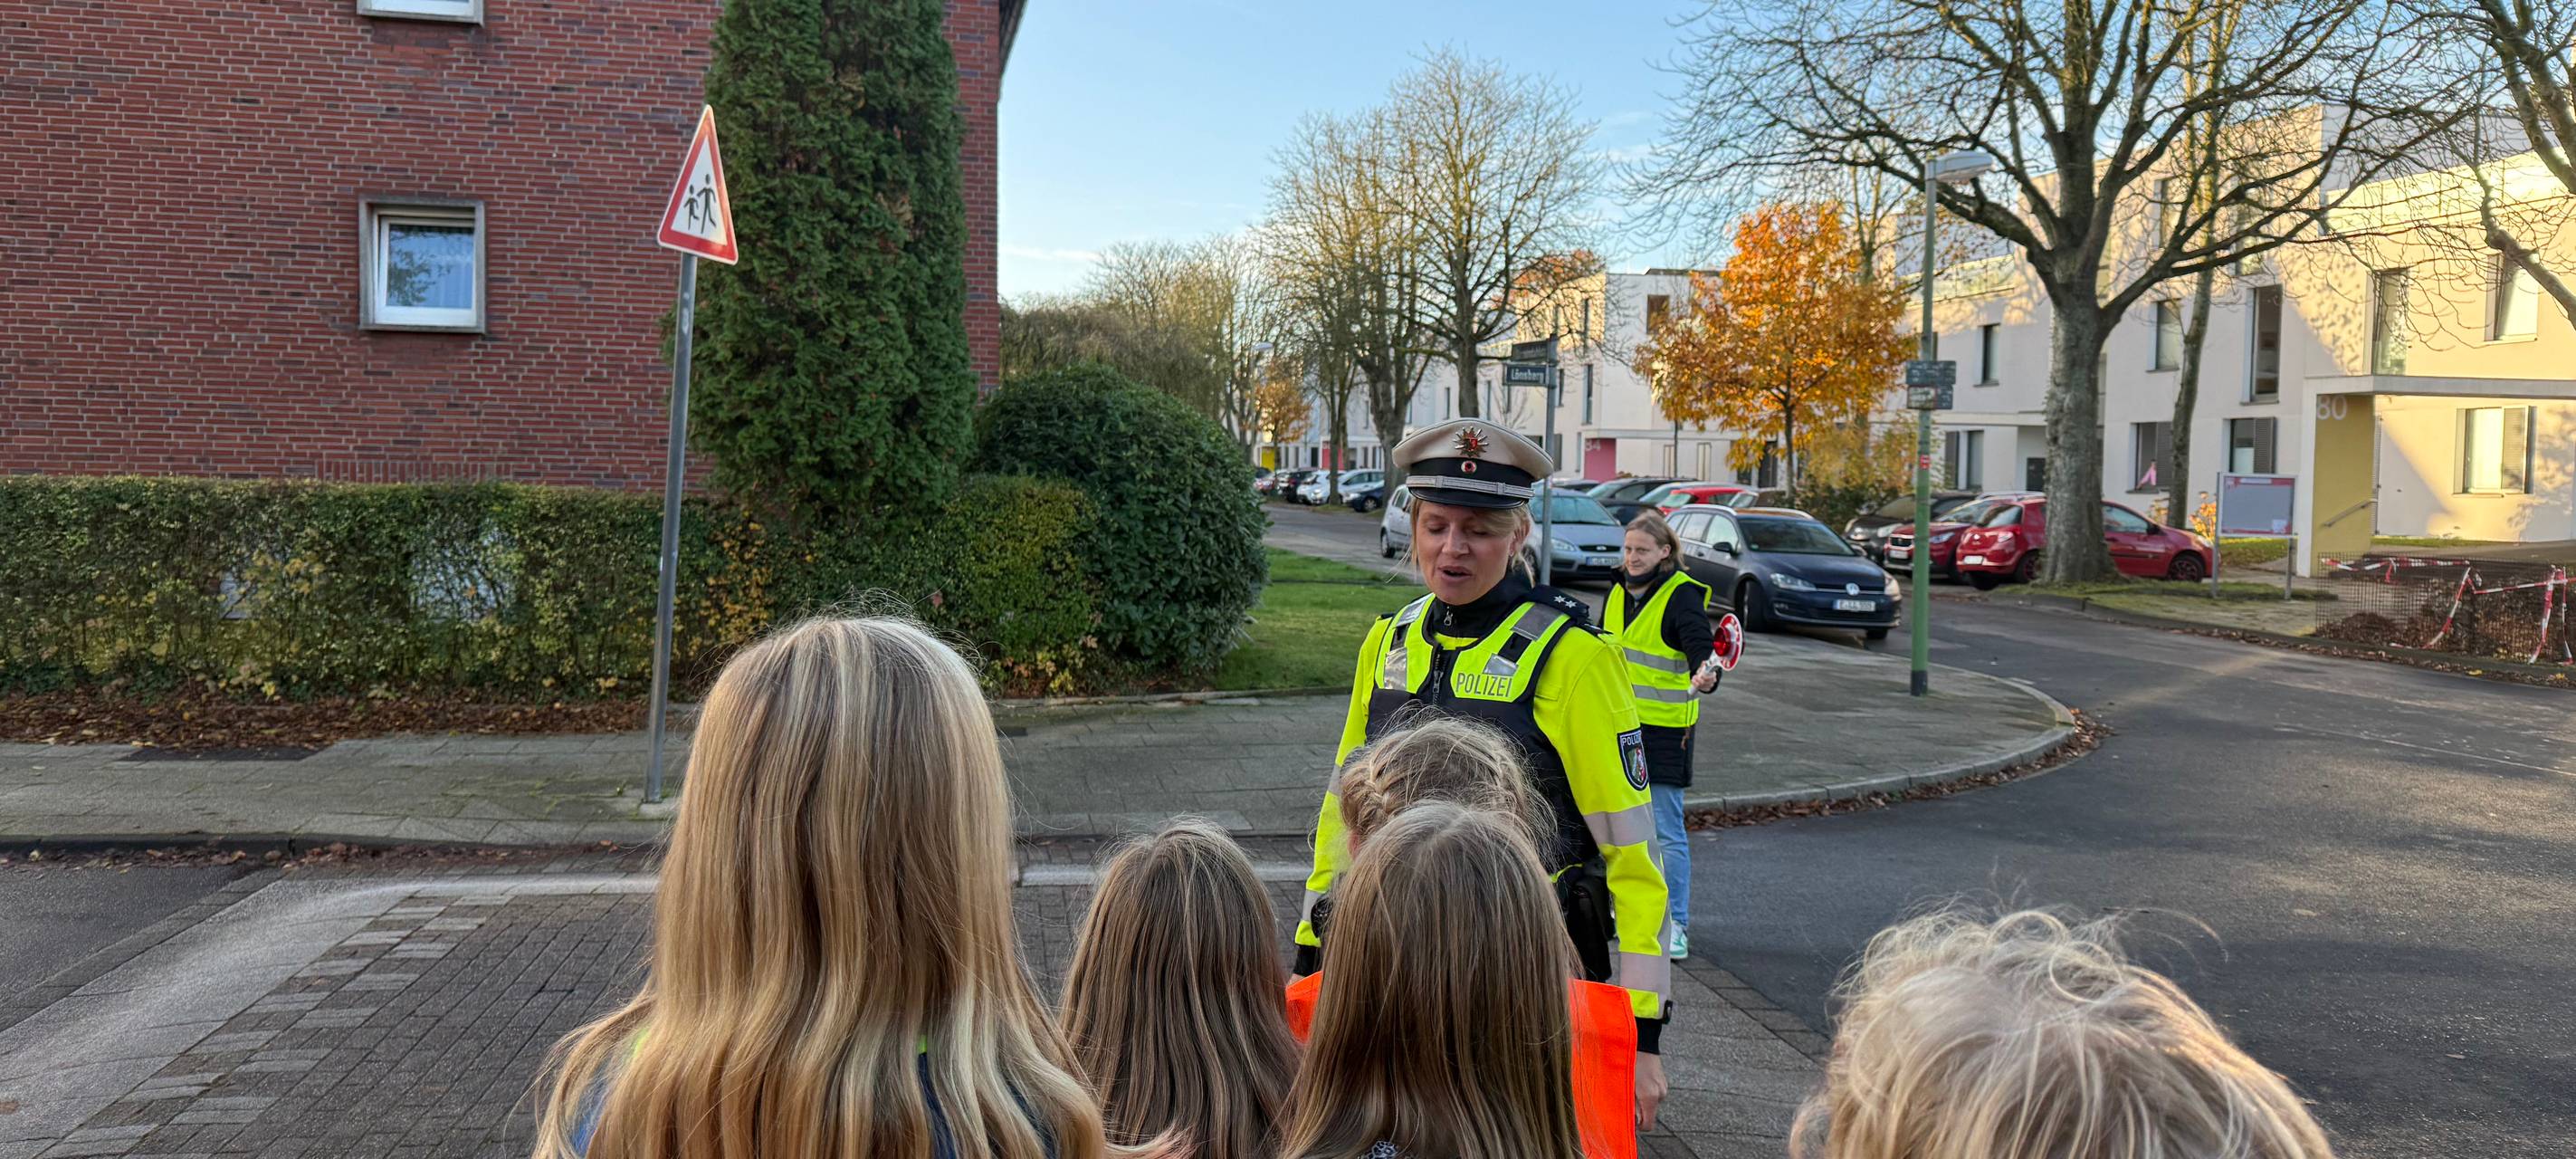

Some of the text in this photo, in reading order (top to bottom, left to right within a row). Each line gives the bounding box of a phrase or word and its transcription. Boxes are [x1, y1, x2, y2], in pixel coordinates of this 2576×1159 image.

[2317, 395, 2348, 420] 80
[1455, 672, 1512, 697] POLIZEI
[1622, 734, 1641, 746] POLIZ
